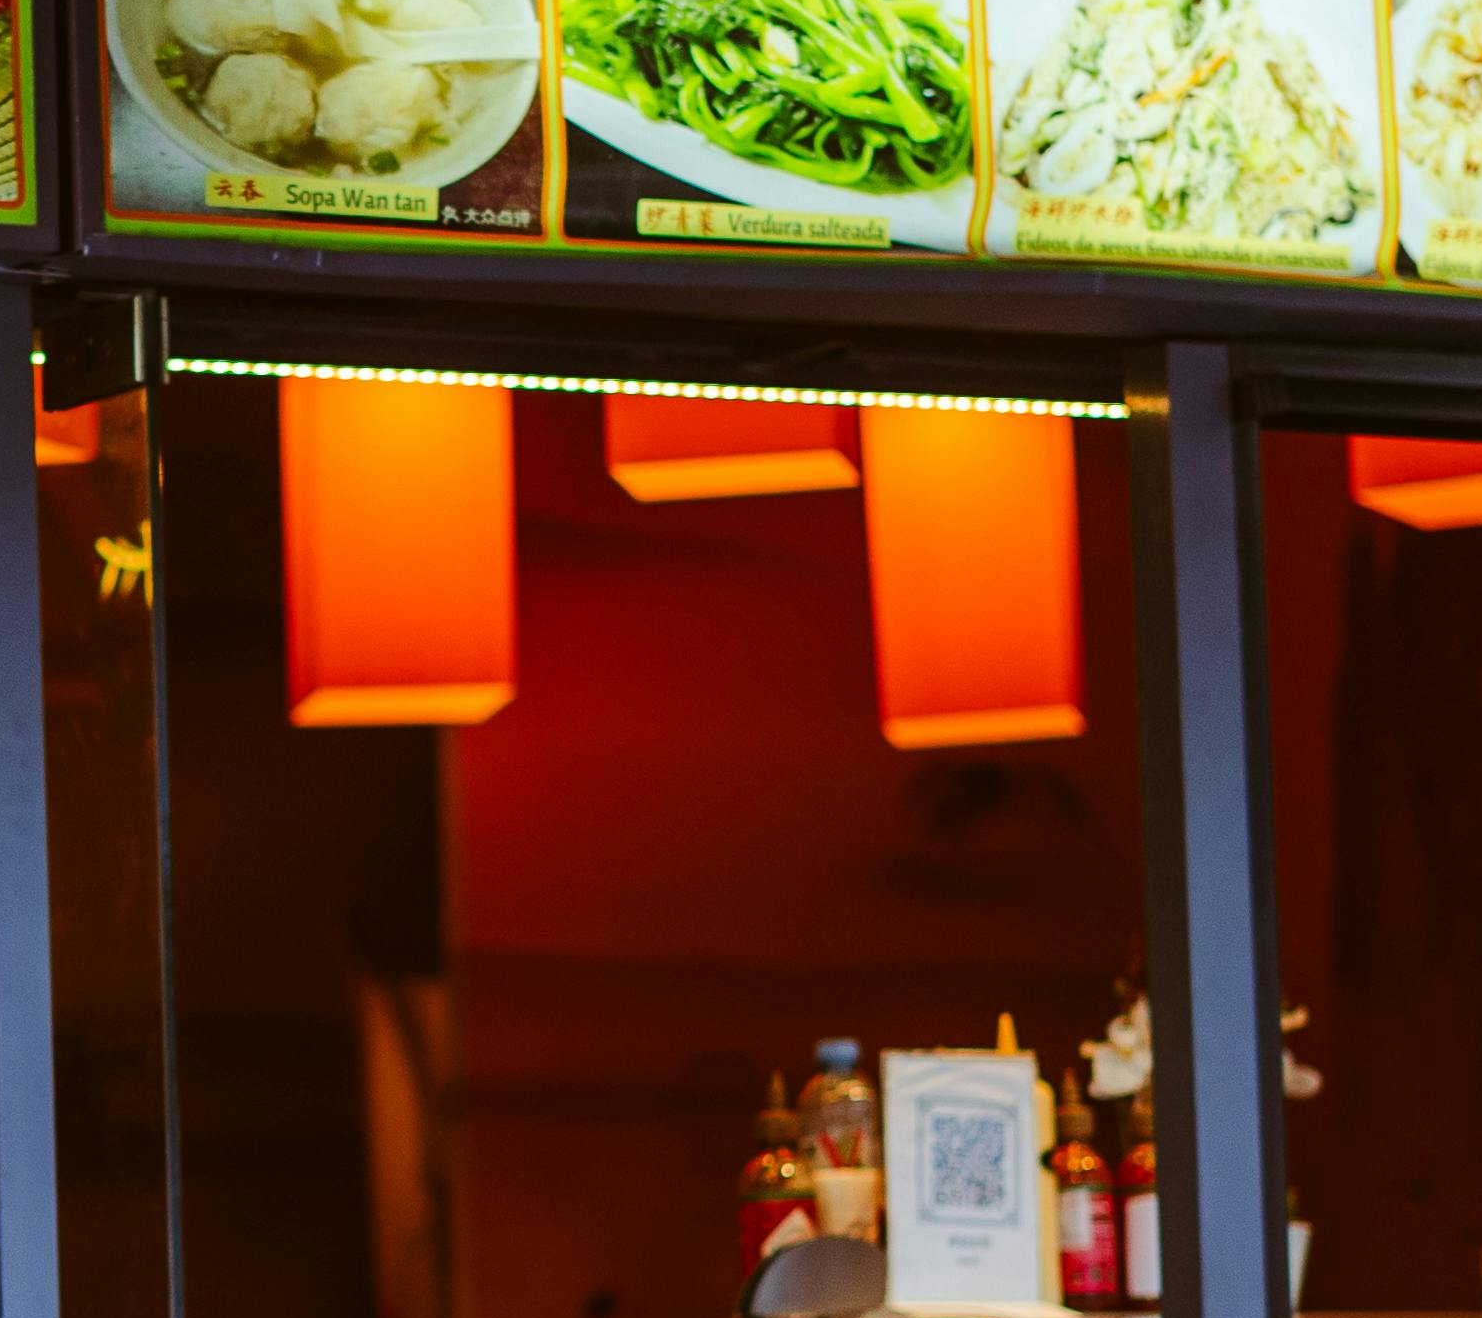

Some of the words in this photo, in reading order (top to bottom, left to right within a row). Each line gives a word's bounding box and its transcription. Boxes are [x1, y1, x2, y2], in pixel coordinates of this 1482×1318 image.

[286, 184, 335, 212] Sopa
[341, 187, 389, 210] Wan
[394, 193, 427, 212] tan
[727, 211, 804, 236] Verdura
[808, 217, 885, 240] salteada
